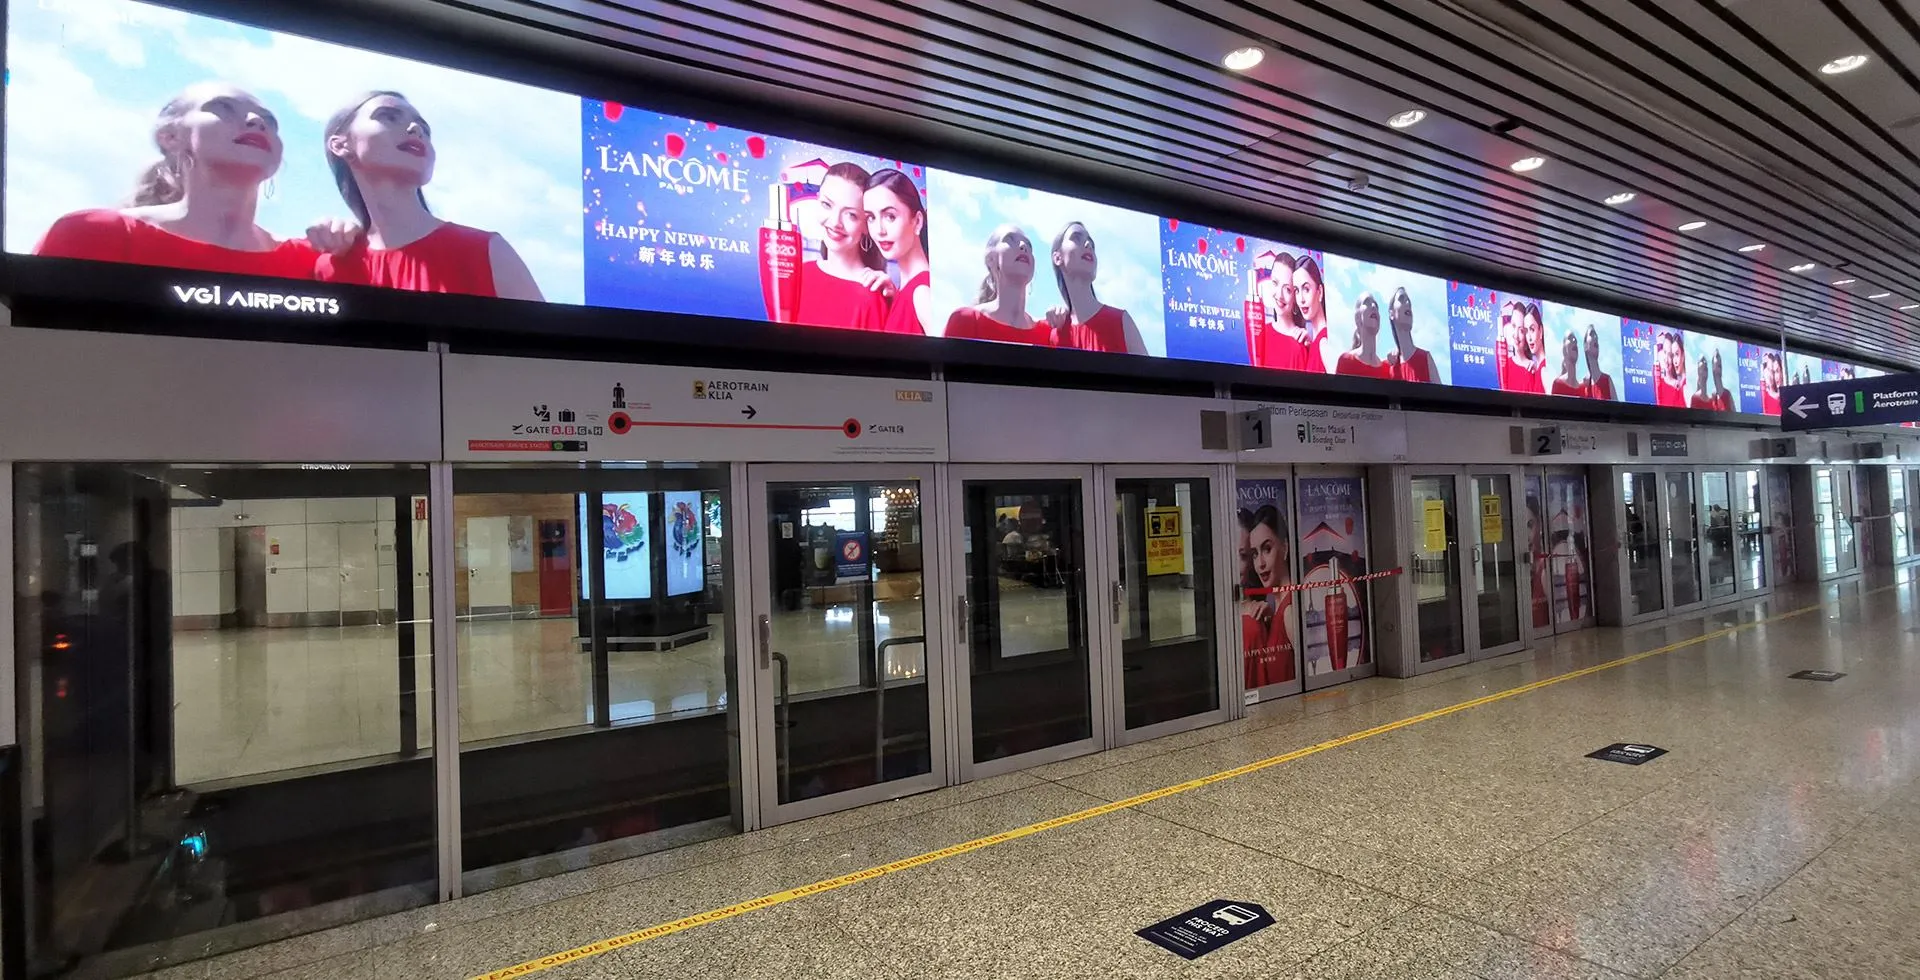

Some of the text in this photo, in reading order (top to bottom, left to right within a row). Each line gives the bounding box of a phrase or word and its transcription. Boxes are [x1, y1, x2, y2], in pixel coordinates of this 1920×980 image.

[659, 182, 694, 195] PARIS
[600, 221, 751, 254] HAPPY NEW YEAR
[638, 246, 715, 270] 新年快乐
[227, 291, 340, 315] AIRPORTS
[1170, 299, 1241, 320] HAPPY NEW YEAR
[708, 381, 769, 391] AEROTRAIN
[708, 391, 733, 400] KLIA
[896, 391, 922, 401] KLIA
[1872, 391, 1918, 400] Platform
[1873, 399, 1919, 408] Aerotrain
[526, 426, 549, 434] GATE
[878, 425, 896, 433] GATE
[1252, 420, 1263, 445] 1
[1537, 435, 1551, 453] 2
[1235, 484, 1279, 500] ANCÔME
[1272, 579, 1335, 593] MAINTENANCE
[1352, 570, 1392, 583] PROGRESS
[792, 833, 1011, 896] PLEASE QUEUE BEHIND YELLOW LINE
[541, 943, 604, 966] QUEUE
[608, 926, 672, 947] BEHIND
[672, 907, 738, 930] YELLOW
[741, 896, 776, 911] LINE
[1185, 919, 1203, 930] THIS
[1202, 926, 1224, 938] WAY
[1191, 916, 1230, 936] PROCEED
